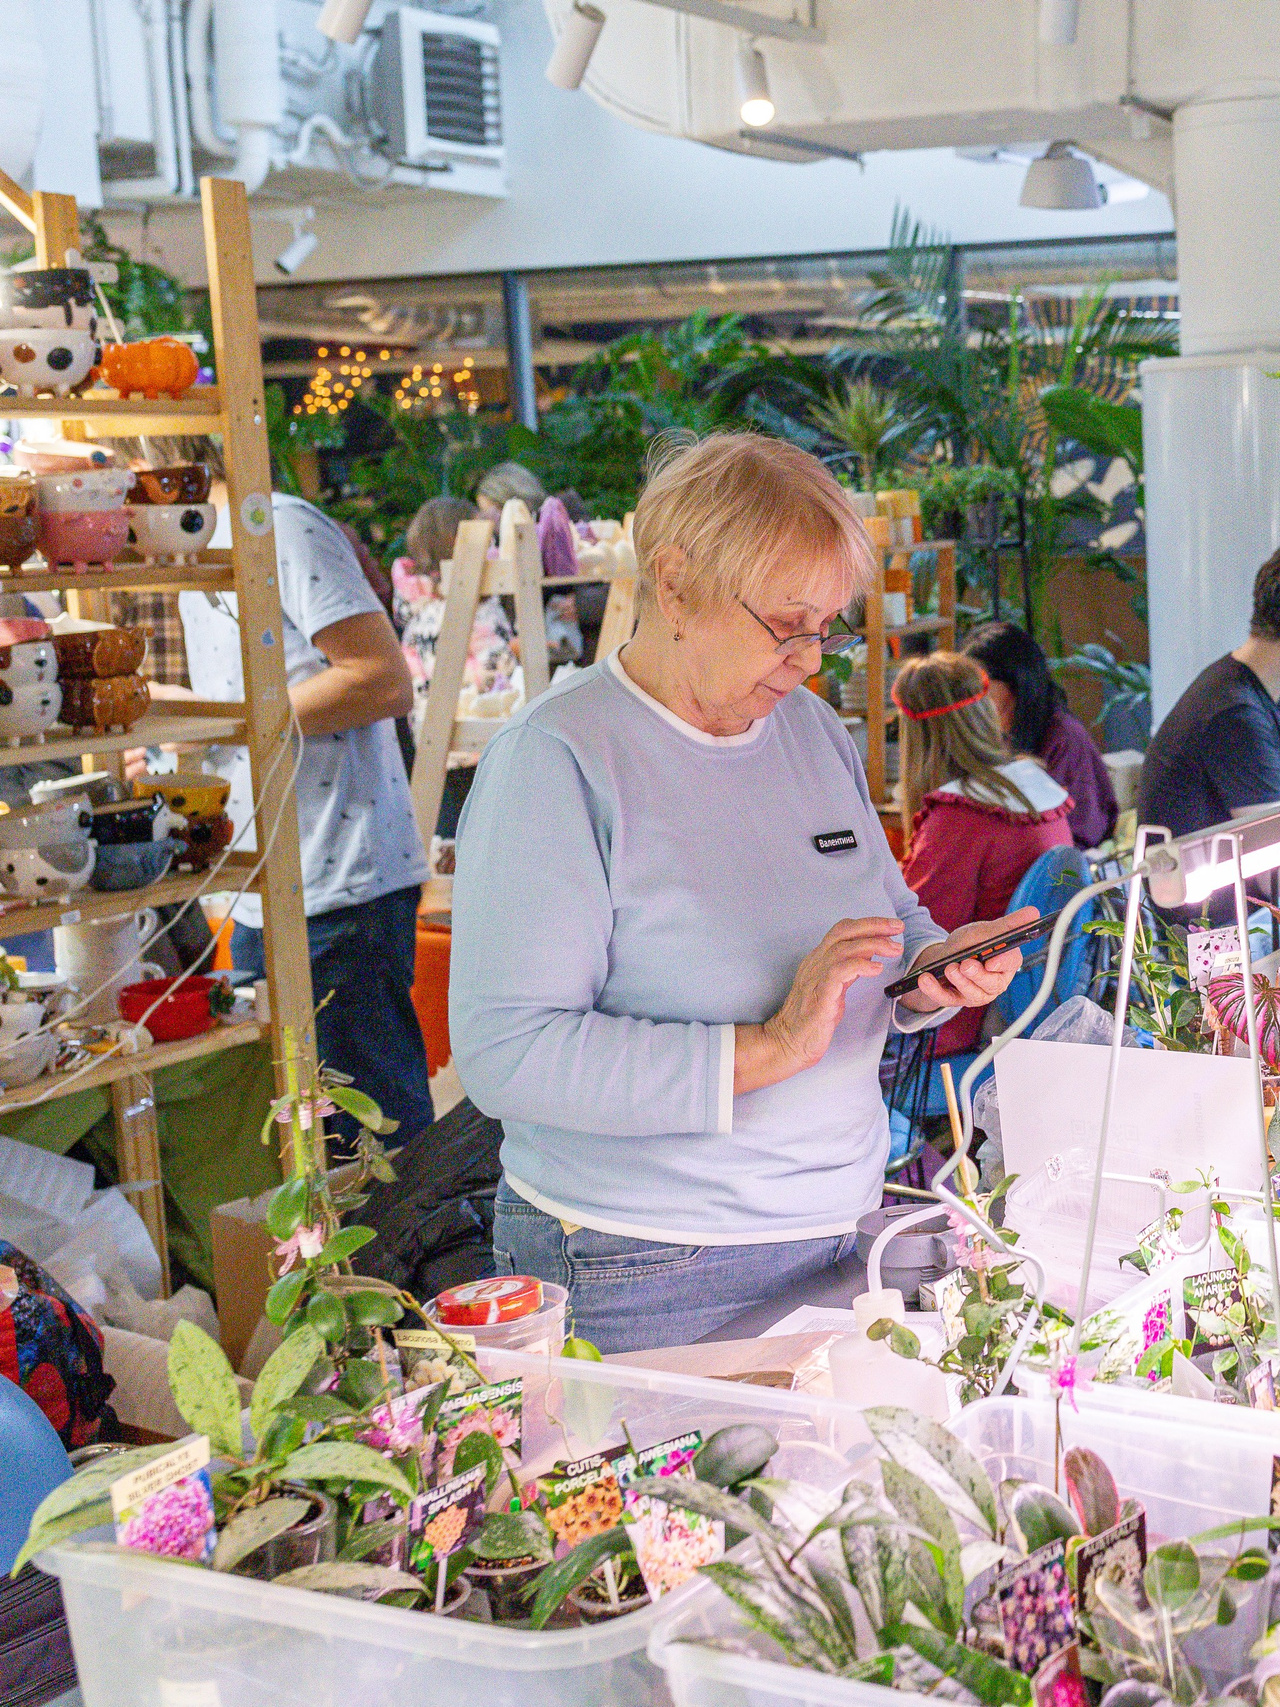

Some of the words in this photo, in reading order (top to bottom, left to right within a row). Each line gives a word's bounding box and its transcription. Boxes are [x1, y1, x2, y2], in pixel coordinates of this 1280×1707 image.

[818, 835, 855, 848] Валентина
[1192, 1269, 1238, 1287] LACUNOSA
[396, 1331, 438, 1344] Lacunosa
[428, 1483, 472, 1515] SPLASH
